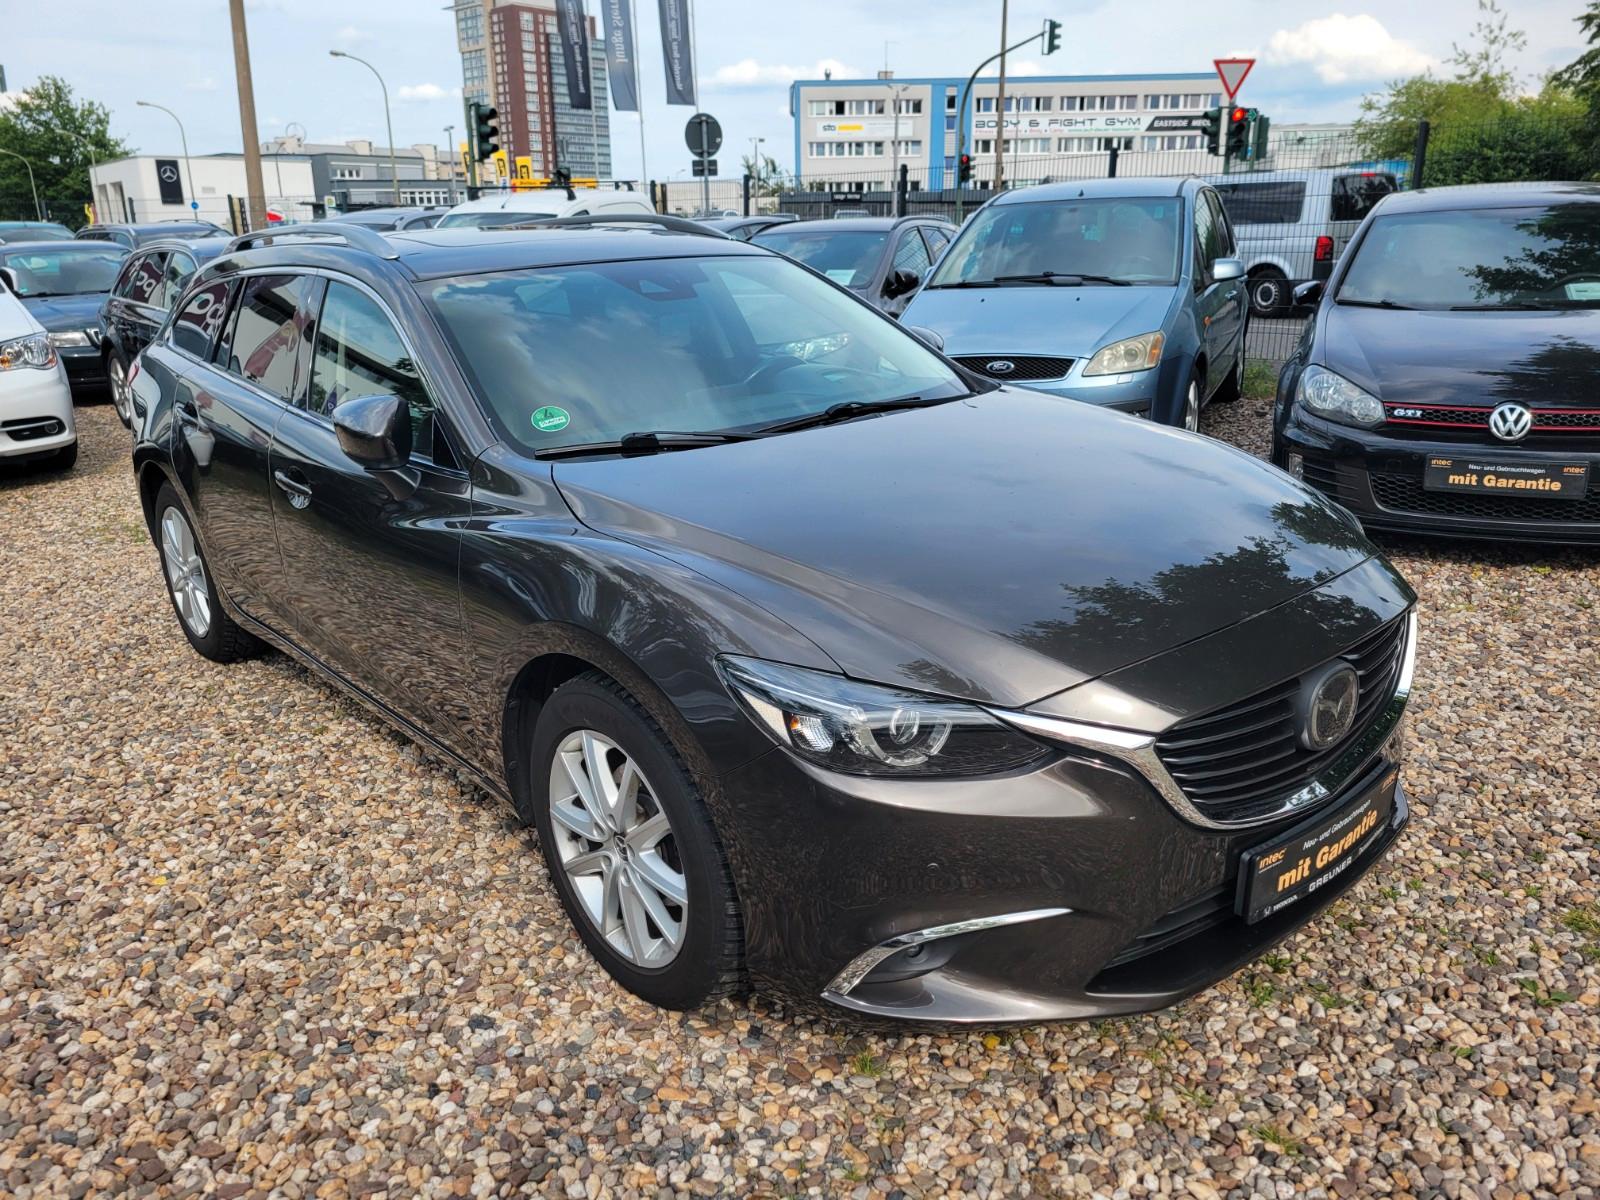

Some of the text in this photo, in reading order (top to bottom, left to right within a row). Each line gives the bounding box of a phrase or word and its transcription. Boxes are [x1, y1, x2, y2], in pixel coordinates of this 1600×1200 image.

[1048, 118, 1097, 127] FIGHT
[1105, 117, 1141, 126] GYM
[1153, 119, 1189, 127] EASTSIDE
[1393, 408, 1423, 418] GTI
[1431, 458, 1452, 466] intec
[1468, 463, 1483, 471] Neu-
[1496, 465, 1546, 475] Gebrauchtwagen
[1563, 466, 1586, 474] intec
[1448, 473, 1562, 491] mit Garantie
[1277, 856, 1312, 892] mit
[1315, 809, 1377, 869] Garantie
[1259, 848, 1286, 869] intec
[1308, 856, 1352, 892] GREUNER
